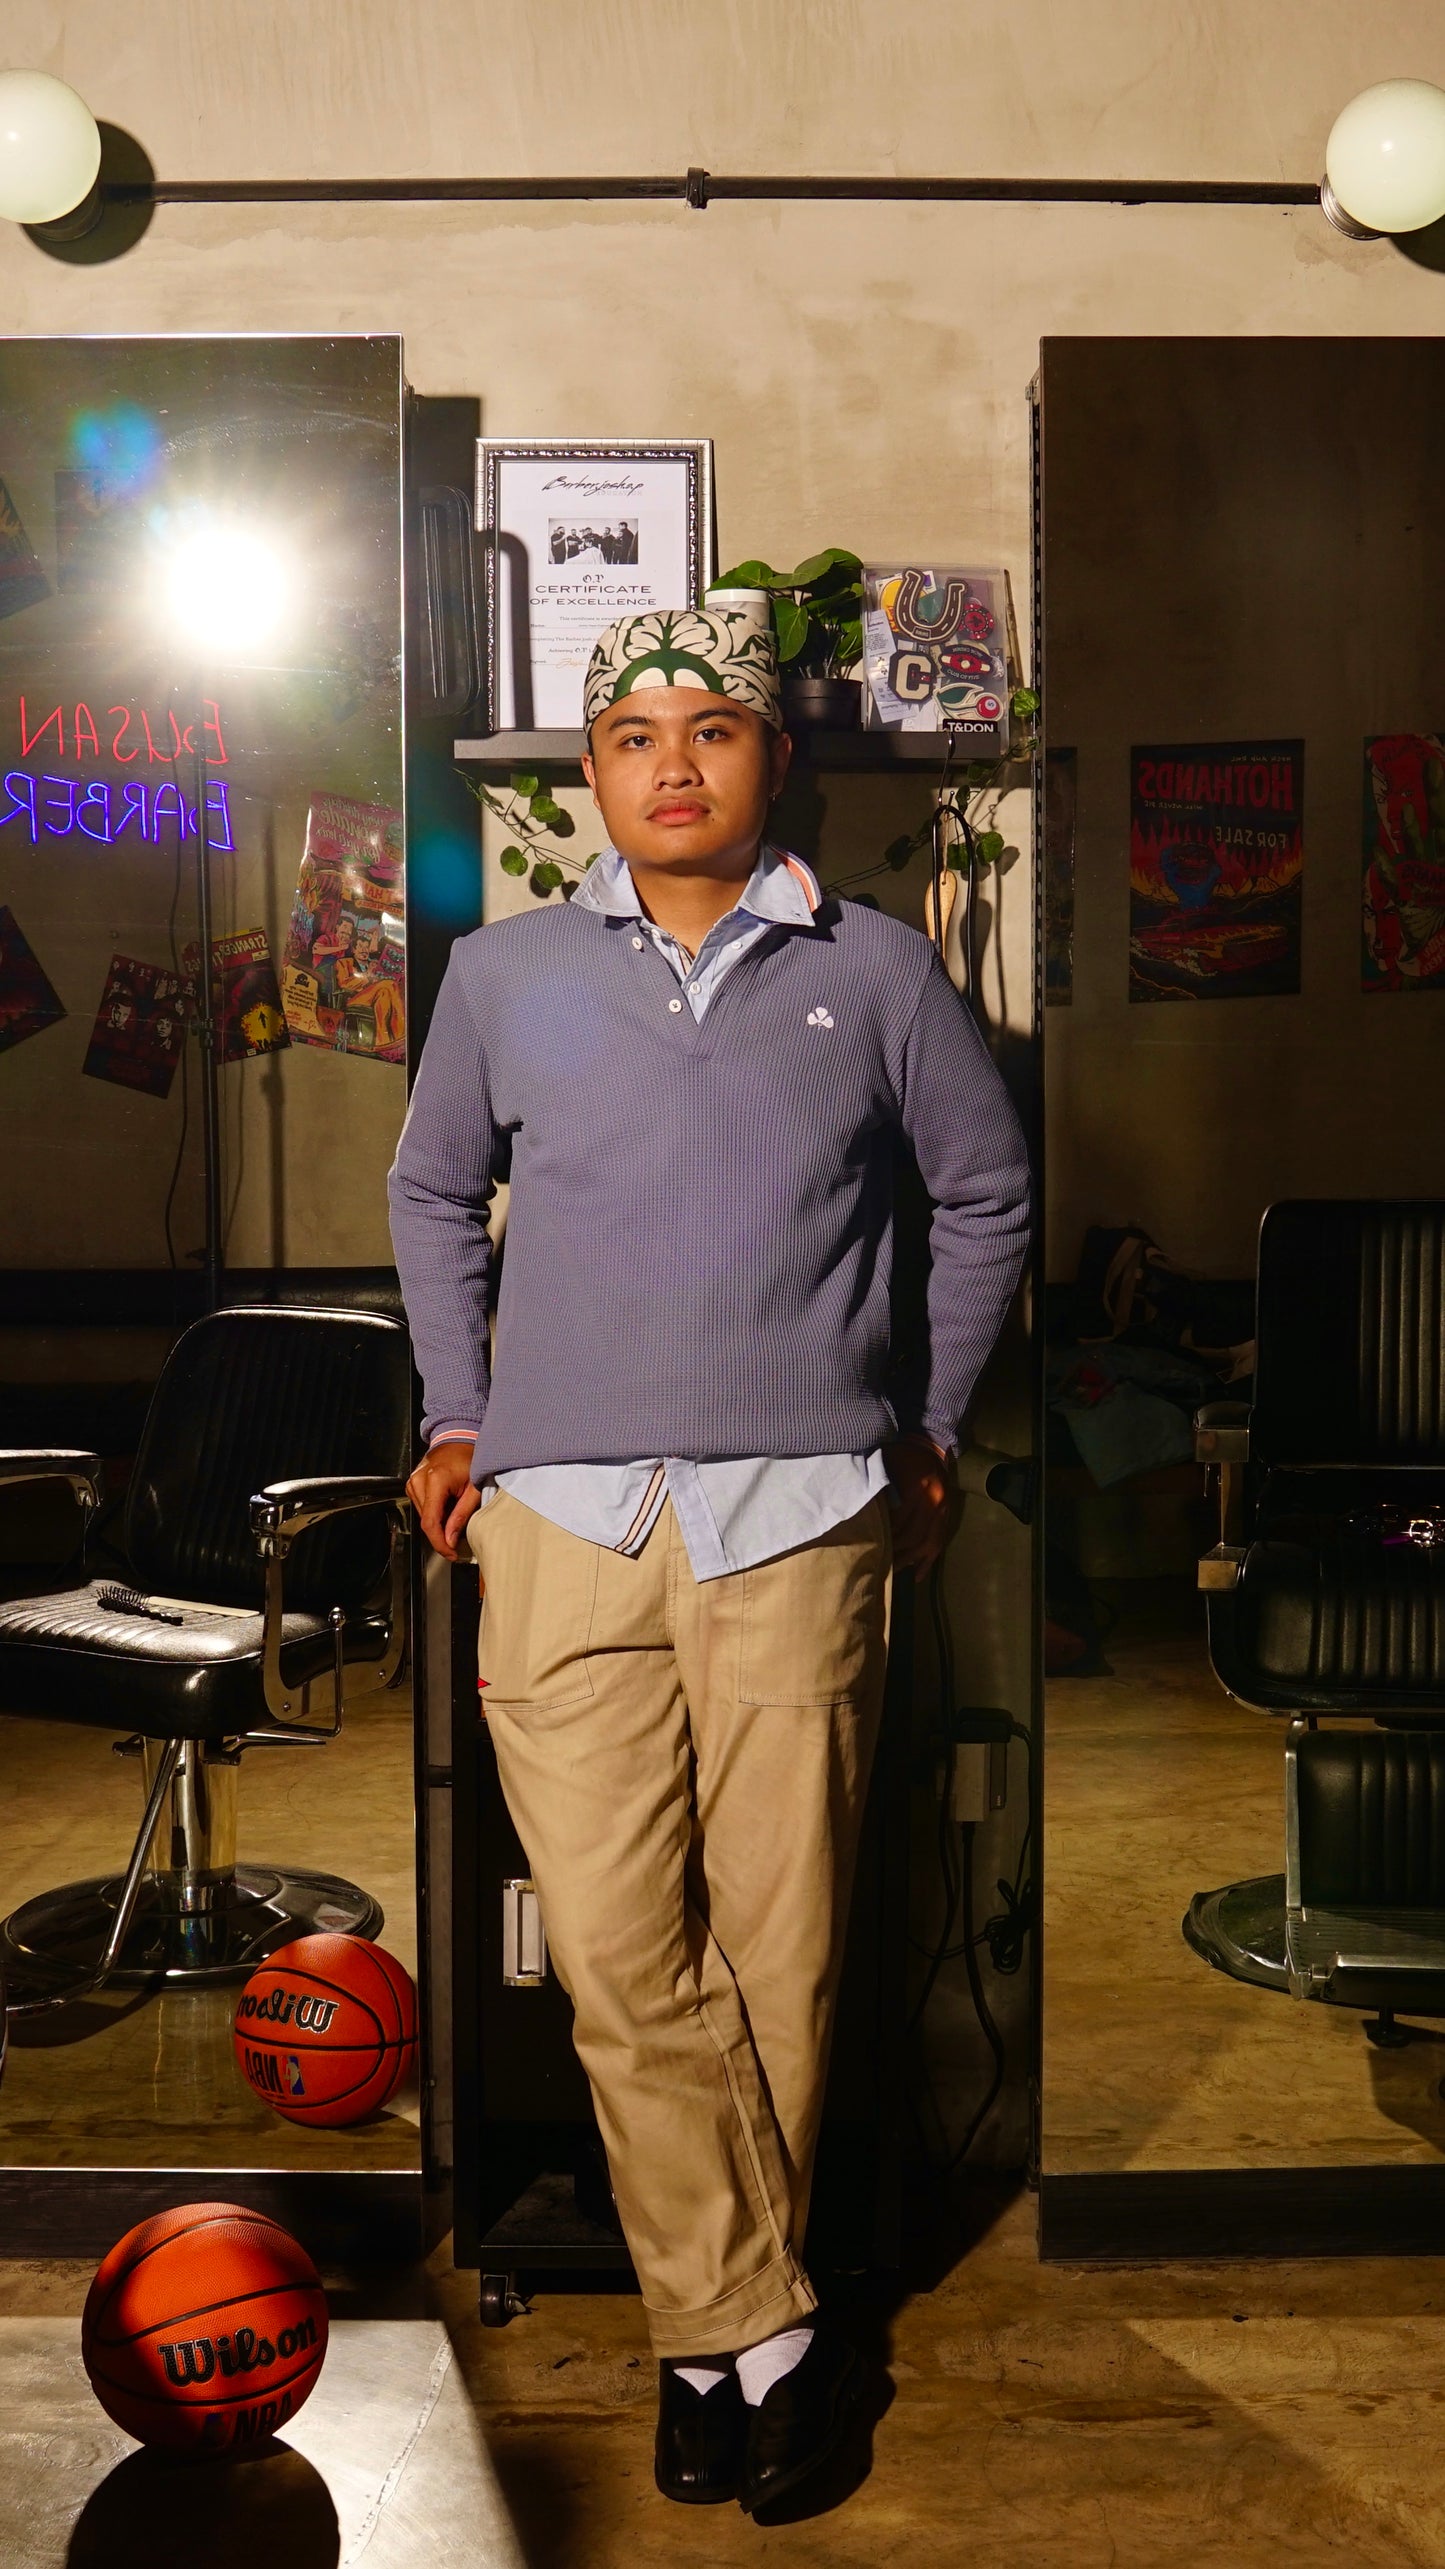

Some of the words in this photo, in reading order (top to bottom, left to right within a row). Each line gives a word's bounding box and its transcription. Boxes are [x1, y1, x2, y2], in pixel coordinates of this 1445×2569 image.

[529, 598, 550, 606] OF
[556, 598, 657, 606] EXCELLENCE
[535, 585, 652, 594] CERTIFICATE
[157, 2314, 318, 2387] Wilson
[231, 2389, 293, 2444] NBA
